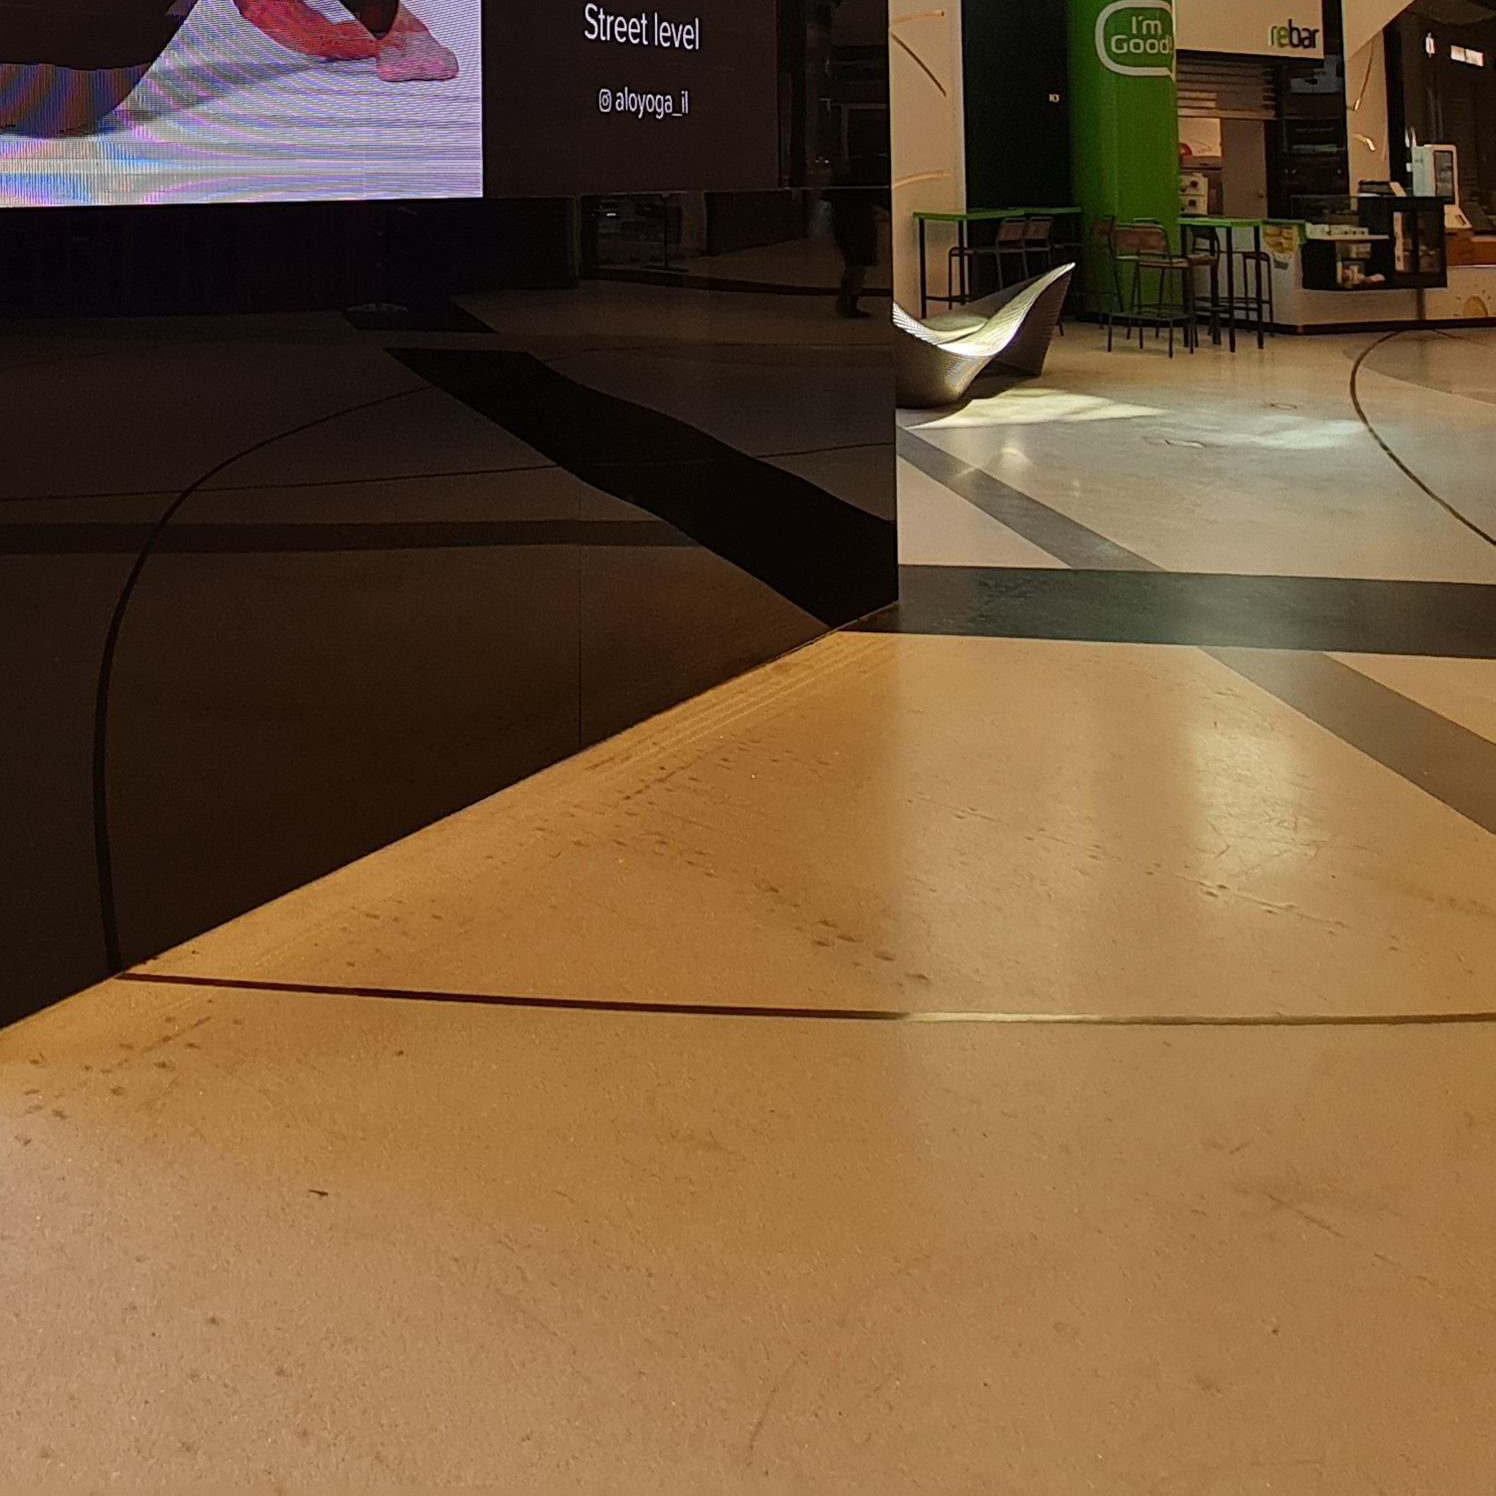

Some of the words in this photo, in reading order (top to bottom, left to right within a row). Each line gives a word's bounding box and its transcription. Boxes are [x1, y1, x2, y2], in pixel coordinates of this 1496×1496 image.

[584, 2, 649, 45] Street
[654, 12, 699, 50] level
[1270, 19, 1320, 49] rebar
